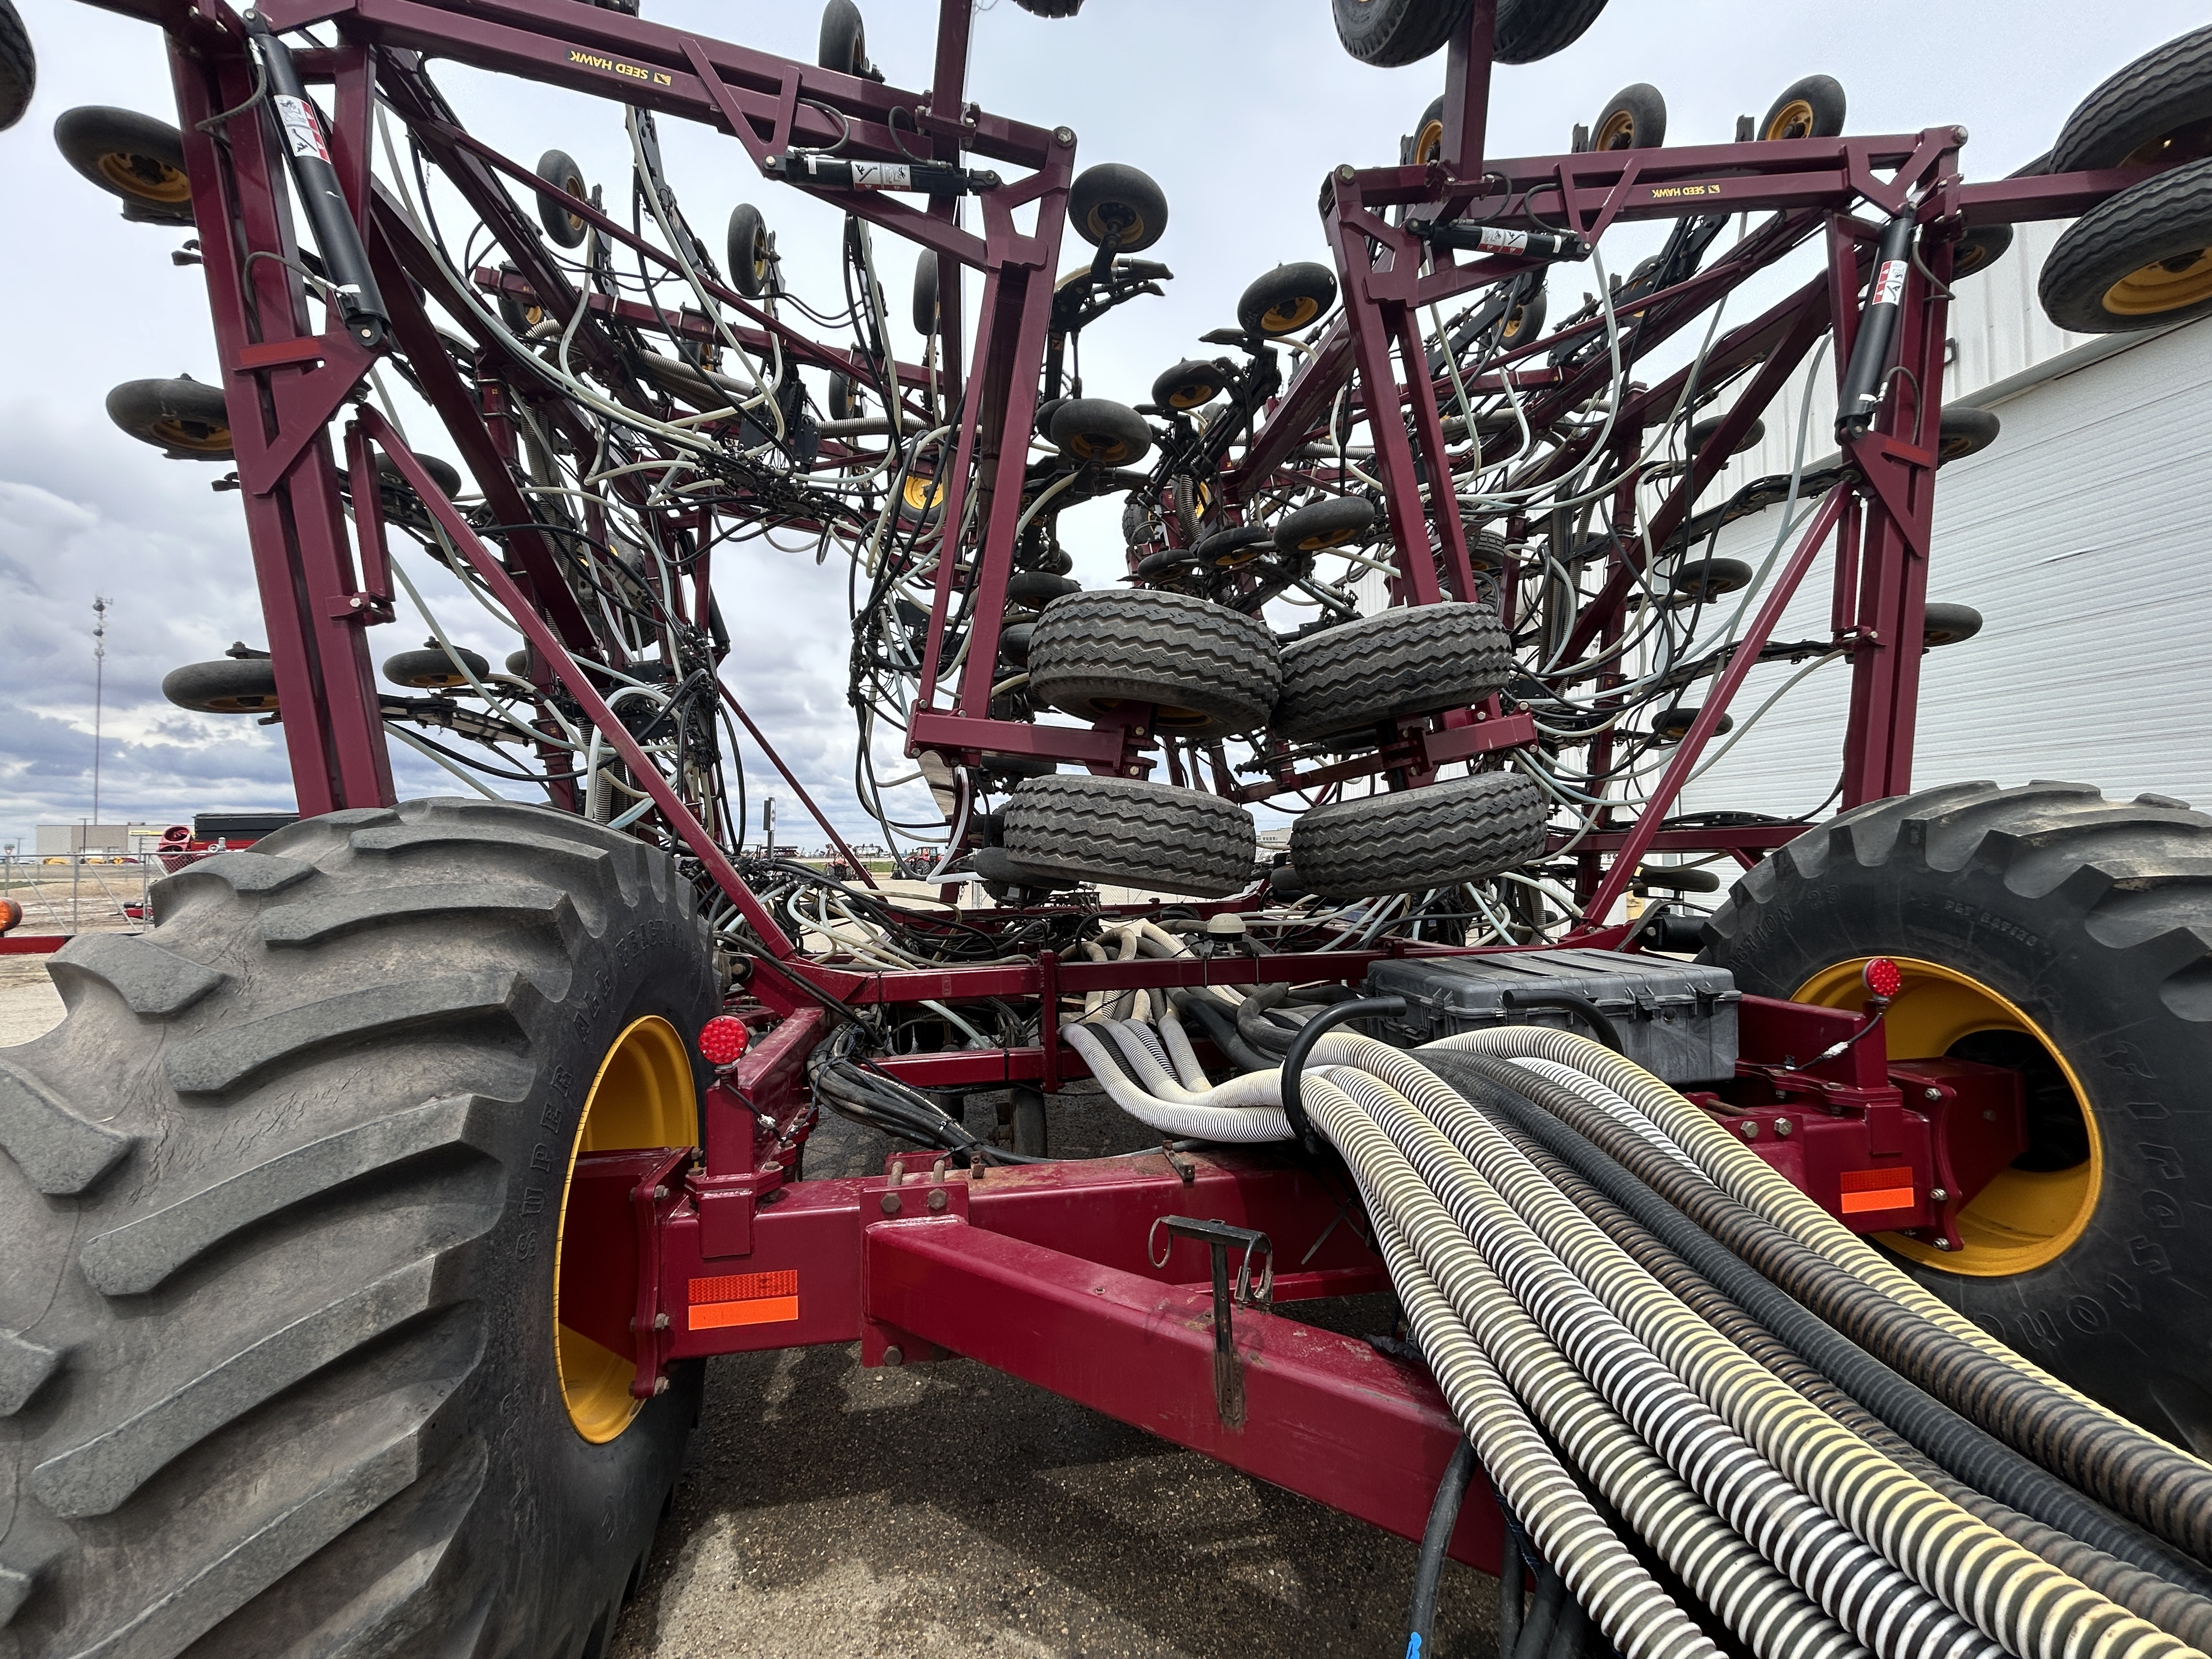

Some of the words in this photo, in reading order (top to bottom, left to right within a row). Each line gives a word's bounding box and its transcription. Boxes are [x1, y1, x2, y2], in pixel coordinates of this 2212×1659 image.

[570, 50, 613, 70] HAWK
[616, 62, 649, 80] SEED
[1651, 187, 1681, 198] HAWK
[1682, 185, 1705, 195] SEED
[1728, 904, 1795, 977] ACTION
[515, 1064, 573, 1261] SUPER
[573, 969, 613, 1043] ALL
